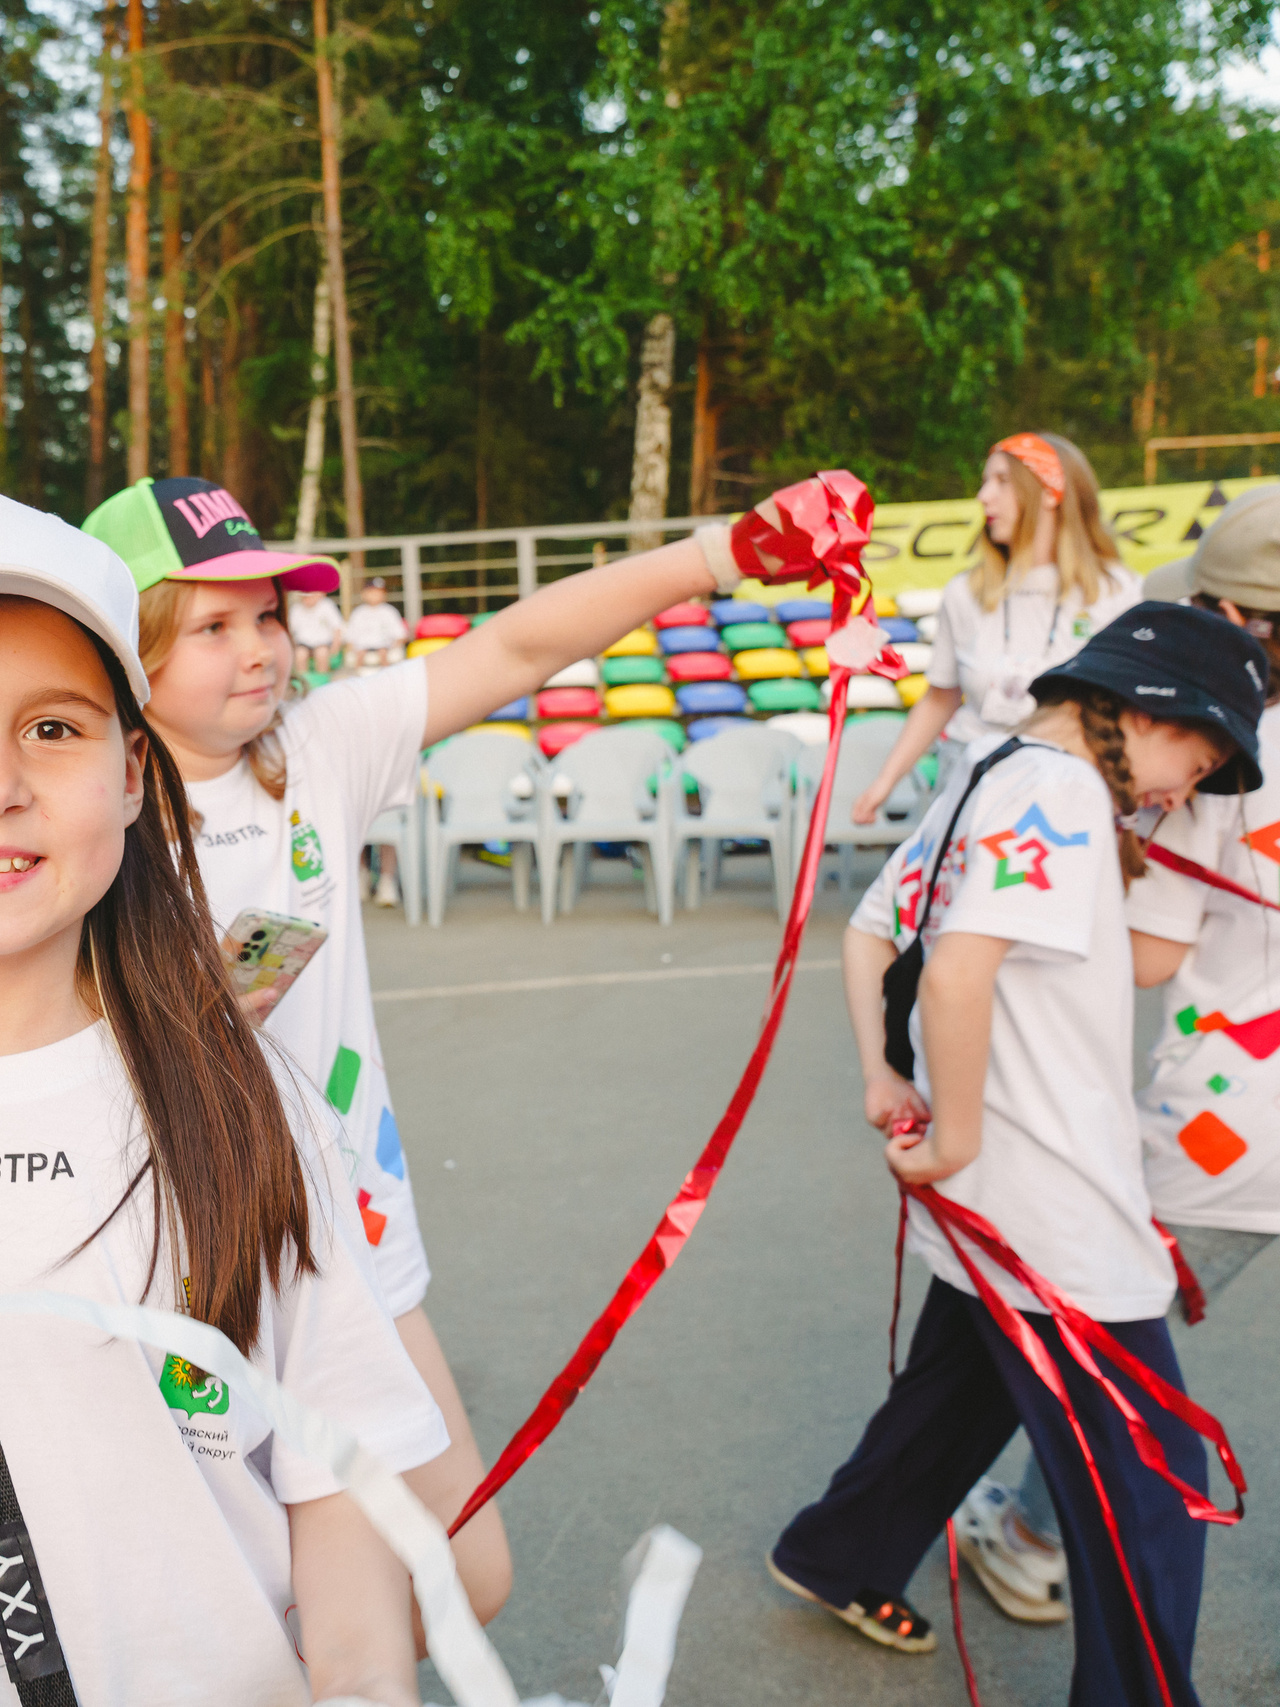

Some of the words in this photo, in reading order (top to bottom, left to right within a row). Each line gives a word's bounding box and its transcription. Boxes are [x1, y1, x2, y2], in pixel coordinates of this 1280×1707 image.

[202, 824, 268, 848] ЗАВТРА
[178, 1425, 229, 1442] овский
[197, 1446, 236, 1460] округ
